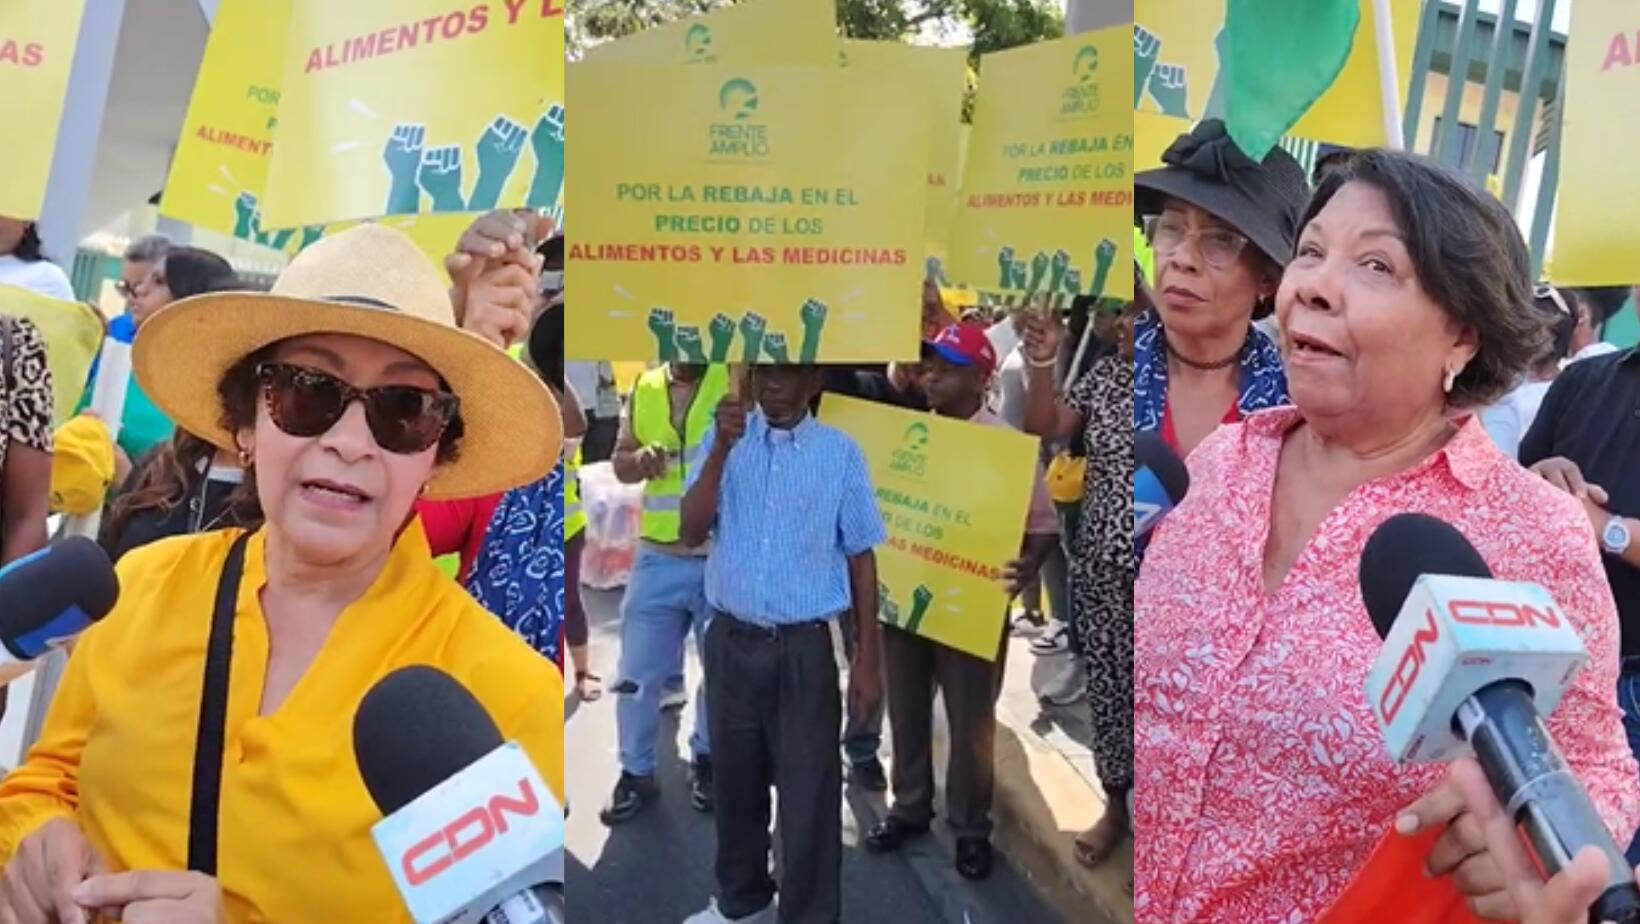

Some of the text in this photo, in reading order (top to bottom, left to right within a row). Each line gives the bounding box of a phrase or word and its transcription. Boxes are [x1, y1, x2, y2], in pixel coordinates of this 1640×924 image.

[304, 4, 489, 74] ALIMENTOS
[709, 124, 767, 140] FRENTE
[709, 141, 769, 156] AMPLIO
[1003, 134, 1133, 158] POR LA REBAJA EN
[1017, 161, 1125, 183] PRECIO DE LOS
[616, 183, 859, 206] POR LA REBAJA EN EL
[967, 193, 1040, 209] ALIMENTOS
[1045, 192, 1055, 206] Y
[1057, 190, 1085, 206] LAS
[655, 215, 823, 235] PRECIO DE LOS
[569, 244, 907, 265] ALIMENTOS Y LAS MEDICINAS
[876, 487, 972, 527] REBAJA EN EL
[895, 515, 912, 532] DE
[916, 522, 943, 540] LOS
[911, 543, 999, 581] MEDICINAS
[1448, 600, 1560, 629] CDN
[1379, 609, 1440, 726] CDN
[402, 777, 539, 887] CDN
